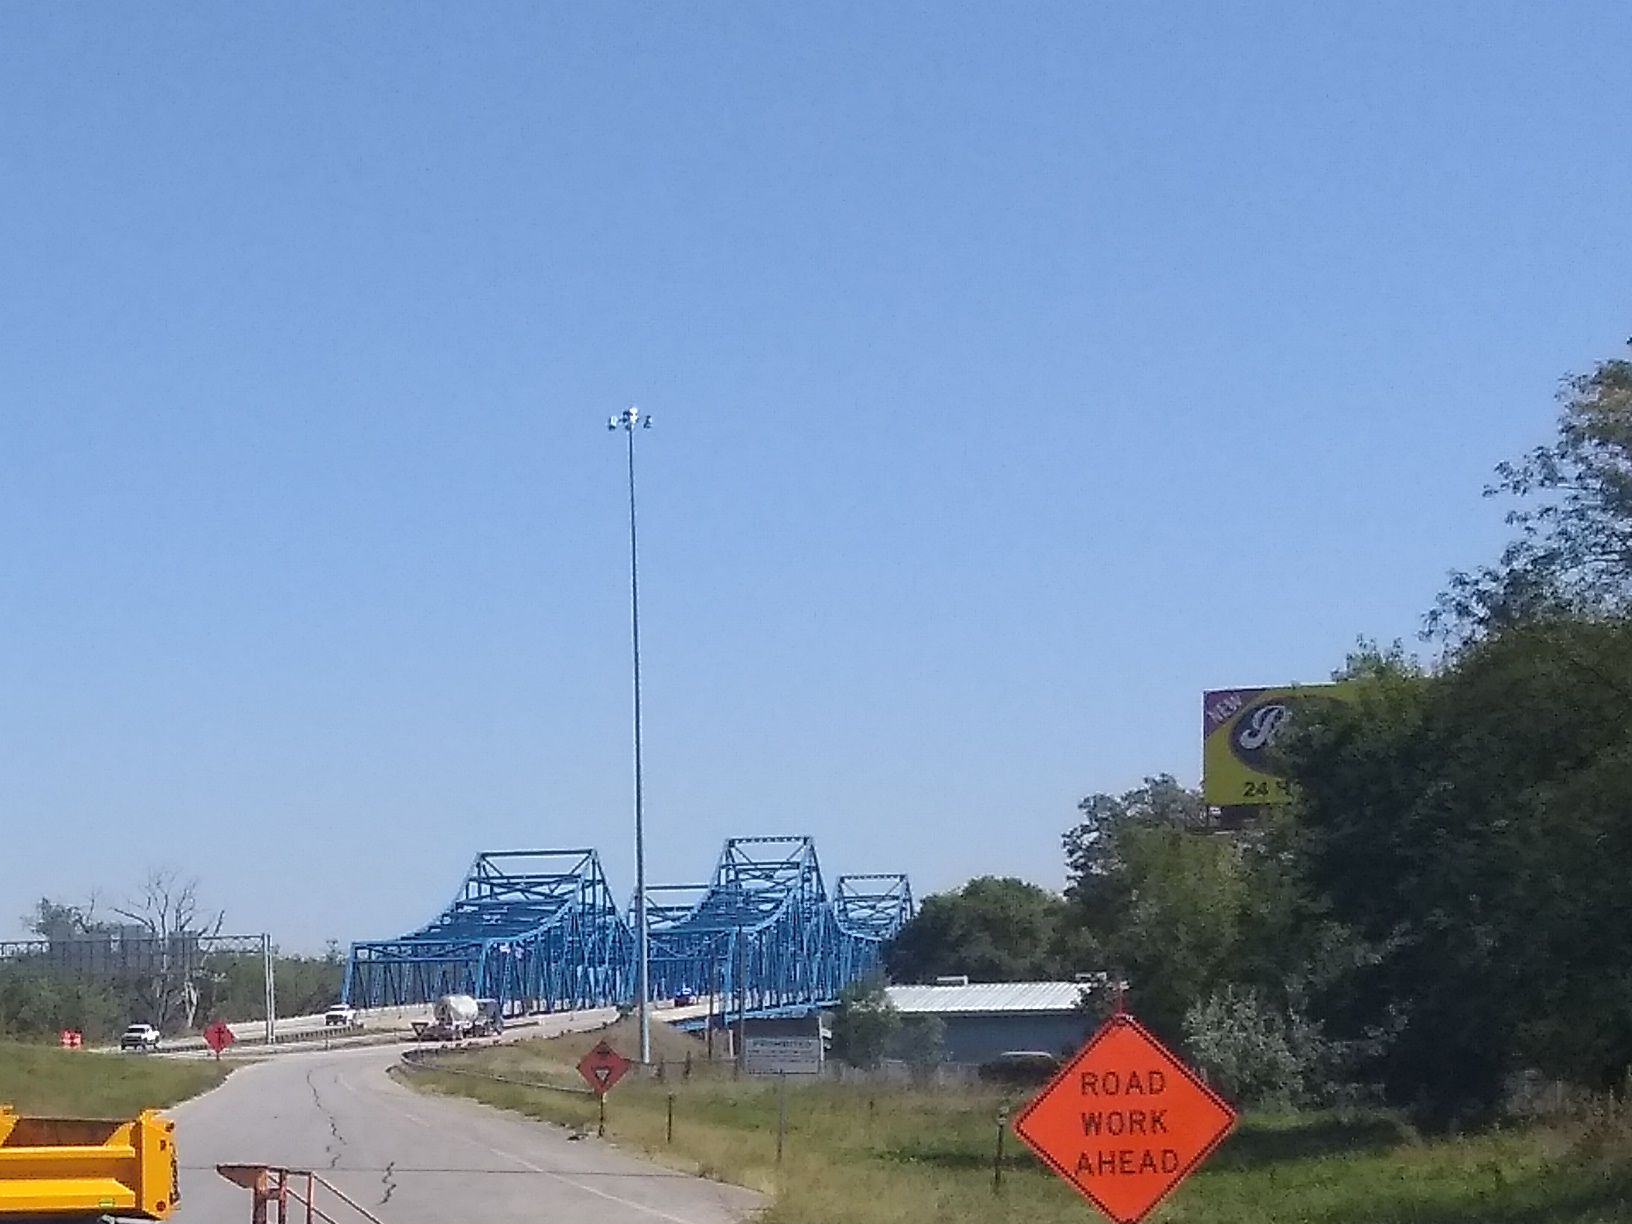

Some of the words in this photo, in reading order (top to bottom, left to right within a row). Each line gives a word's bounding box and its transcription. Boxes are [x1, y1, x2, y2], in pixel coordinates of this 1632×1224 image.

[1080, 1071, 1167, 1096] ROAD
[1081, 1109, 1170, 1136] WORK
[1074, 1149, 1180, 1176] AHEAD
